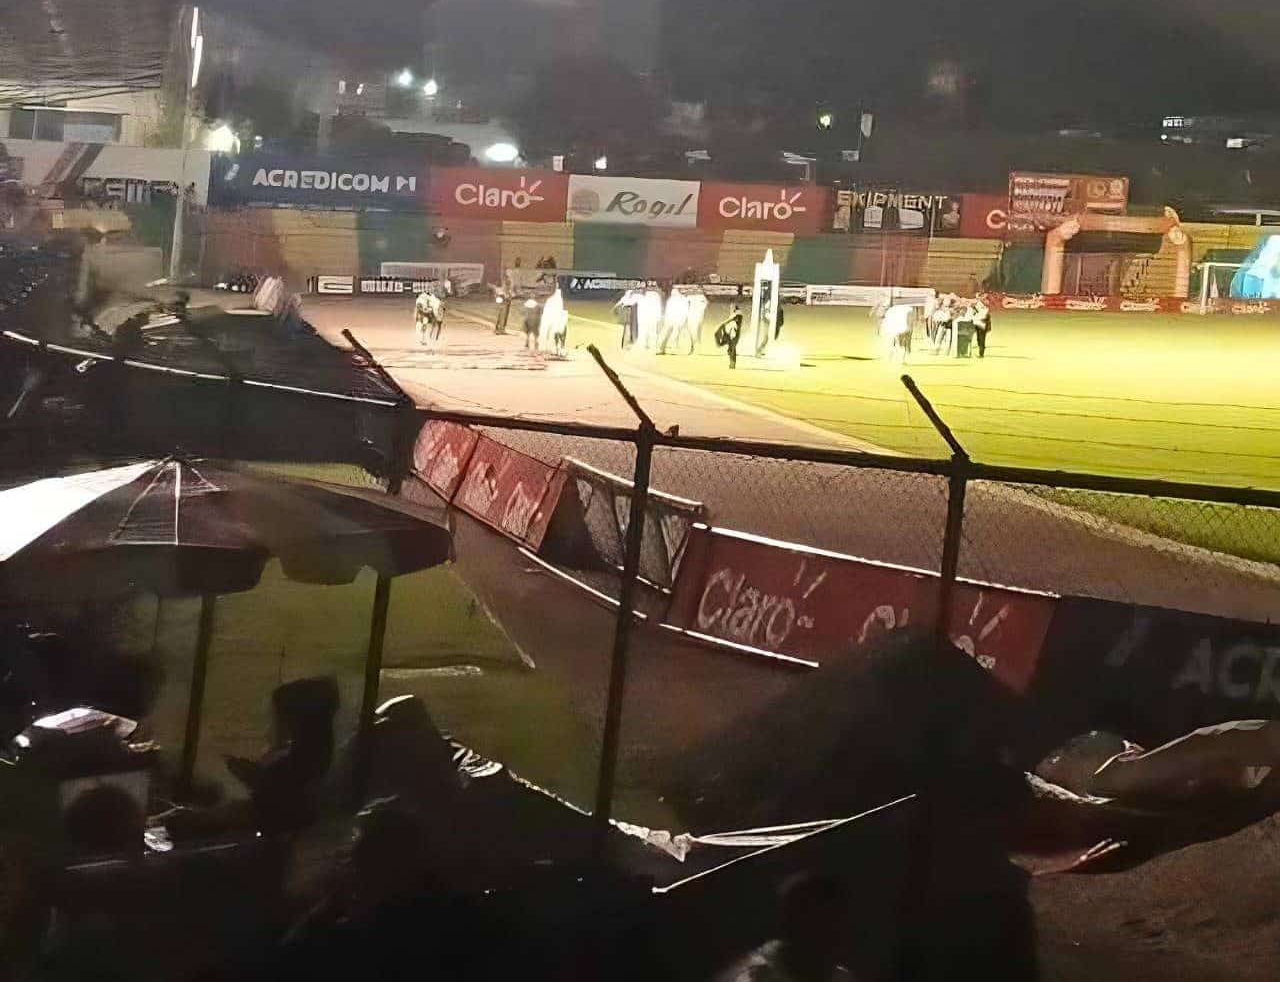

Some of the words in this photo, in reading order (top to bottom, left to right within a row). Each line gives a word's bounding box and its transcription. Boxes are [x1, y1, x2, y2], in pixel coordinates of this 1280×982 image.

[253, 168, 390, 193] ACREDICOM
[454, 181, 532, 210] Claro
[605, 191, 694, 216] Rogil
[718, 196, 794, 220] Claro
[697, 568, 797, 649] Claro
